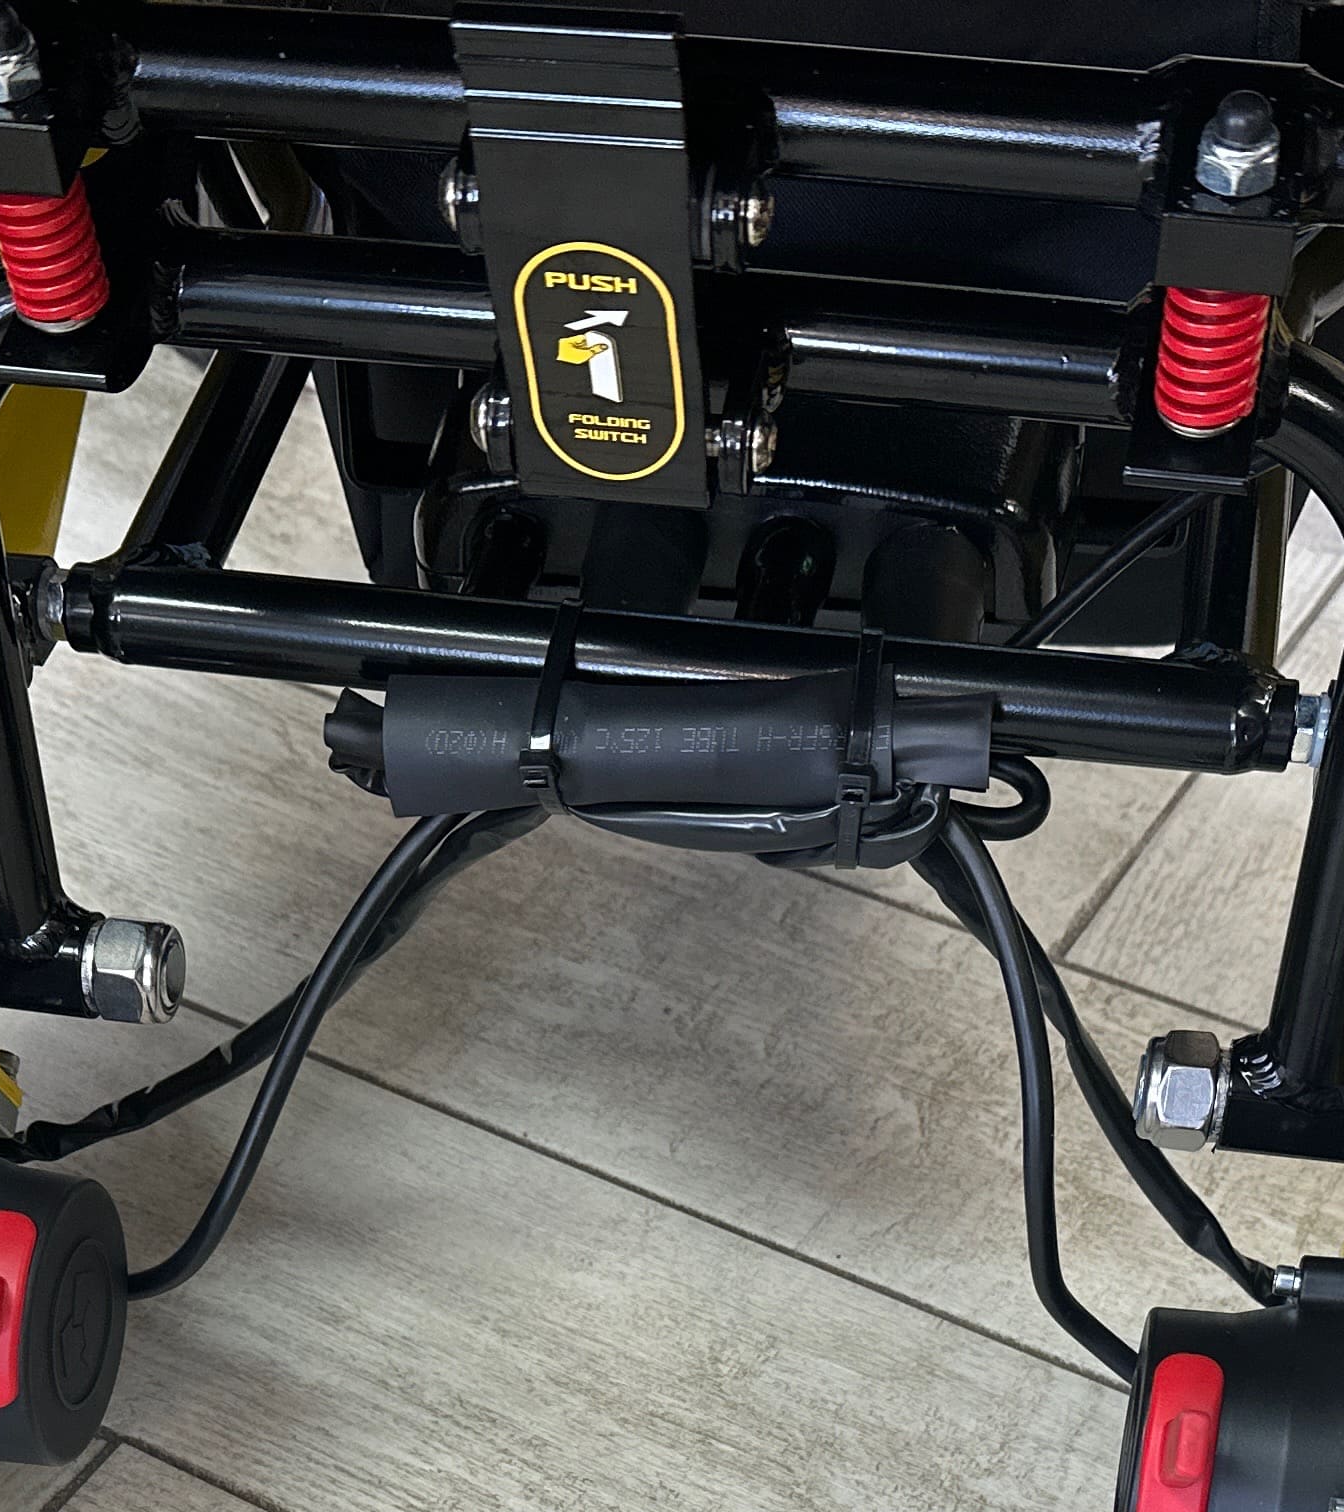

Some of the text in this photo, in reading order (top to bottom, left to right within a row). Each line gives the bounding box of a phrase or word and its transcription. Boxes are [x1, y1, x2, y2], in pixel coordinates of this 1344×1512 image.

[544, 271, 638, 294] PUSH
[568, 413, 651, 430] FOLDING
[574, 428, 647, 444] SWITCH
[680, 727, 739, 753] TUBE
